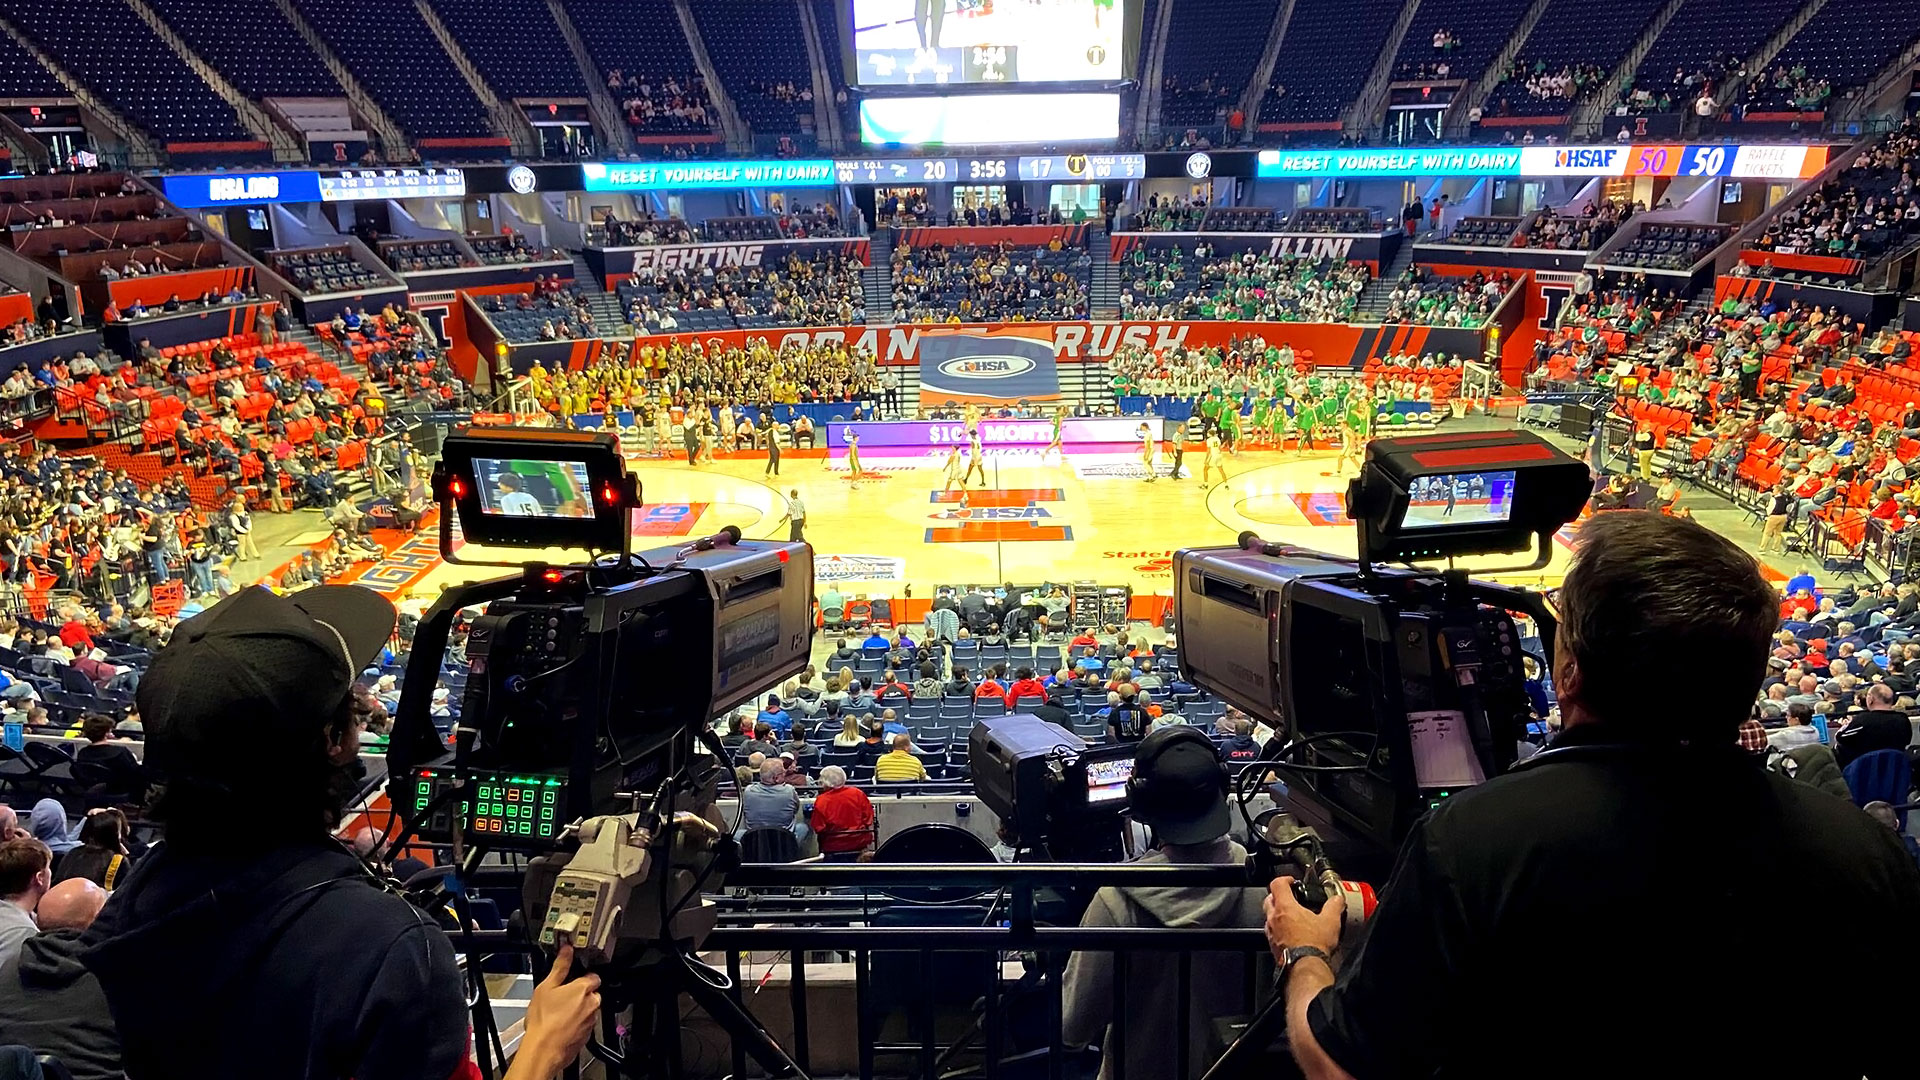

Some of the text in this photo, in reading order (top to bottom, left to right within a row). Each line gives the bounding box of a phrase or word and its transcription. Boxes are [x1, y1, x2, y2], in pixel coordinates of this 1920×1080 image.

[1283, 153, 1519, 171] RESET YOURSELF WITH DAIRY
[1635, 147, 1668, 174] 50
[1689, 147, 1725, 176] 50
[1748, 148, 1787, 160] RAFFLE
[610, 165, 831, 185] RESET YOURSELF WITH DAIRY
[868, 170, 876, 182] 4
[923, 161, 946, 180] 20
[970, 160, 1006, 179] 3:56
[1030, 159, 1052, 178] 17
[1744, 163, 1785, 175] TICKETS
[1268, 237, 1353, 259] ILLINI
[633, 246, 764, 273] FIGHTING
[518, 503, 534, 517] 15
